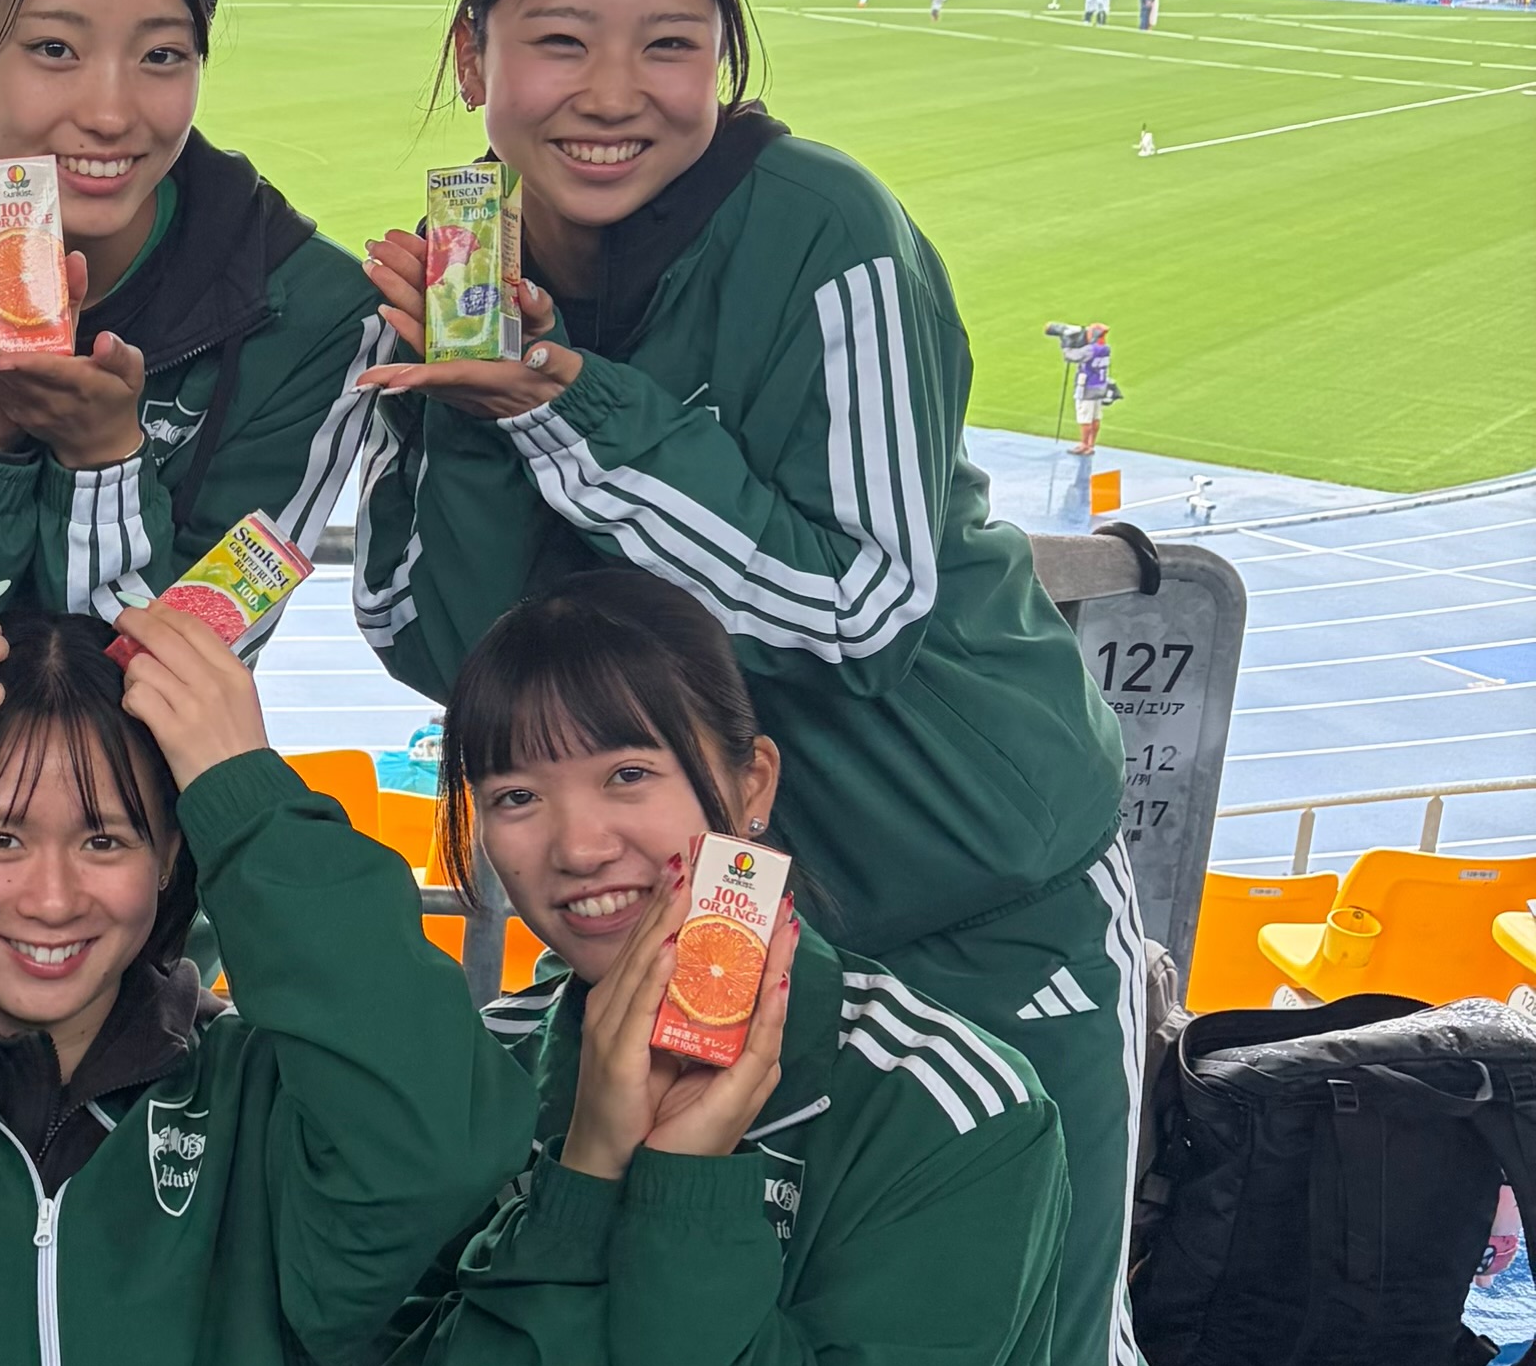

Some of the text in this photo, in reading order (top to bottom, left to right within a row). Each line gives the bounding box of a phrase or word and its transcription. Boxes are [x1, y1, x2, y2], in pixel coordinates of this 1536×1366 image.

[430, 168, 497, 189] Sunkist
[442, 186, 484, 199] MUSCAT
[449, 197, 477, 207] BLEND
[229, 542, 277, 590] GRAPEFRUIT
[233, 527, 289, 590] Sunkist
[234, 559, 259, 585] BLEND
[1098, 642, 1194, 693] 127
[1108, 699, 1185, 716] rea/エリア
[699, 898, 768, 926] ORANGE
[703, 1036, 737, 1053] オレンジ
